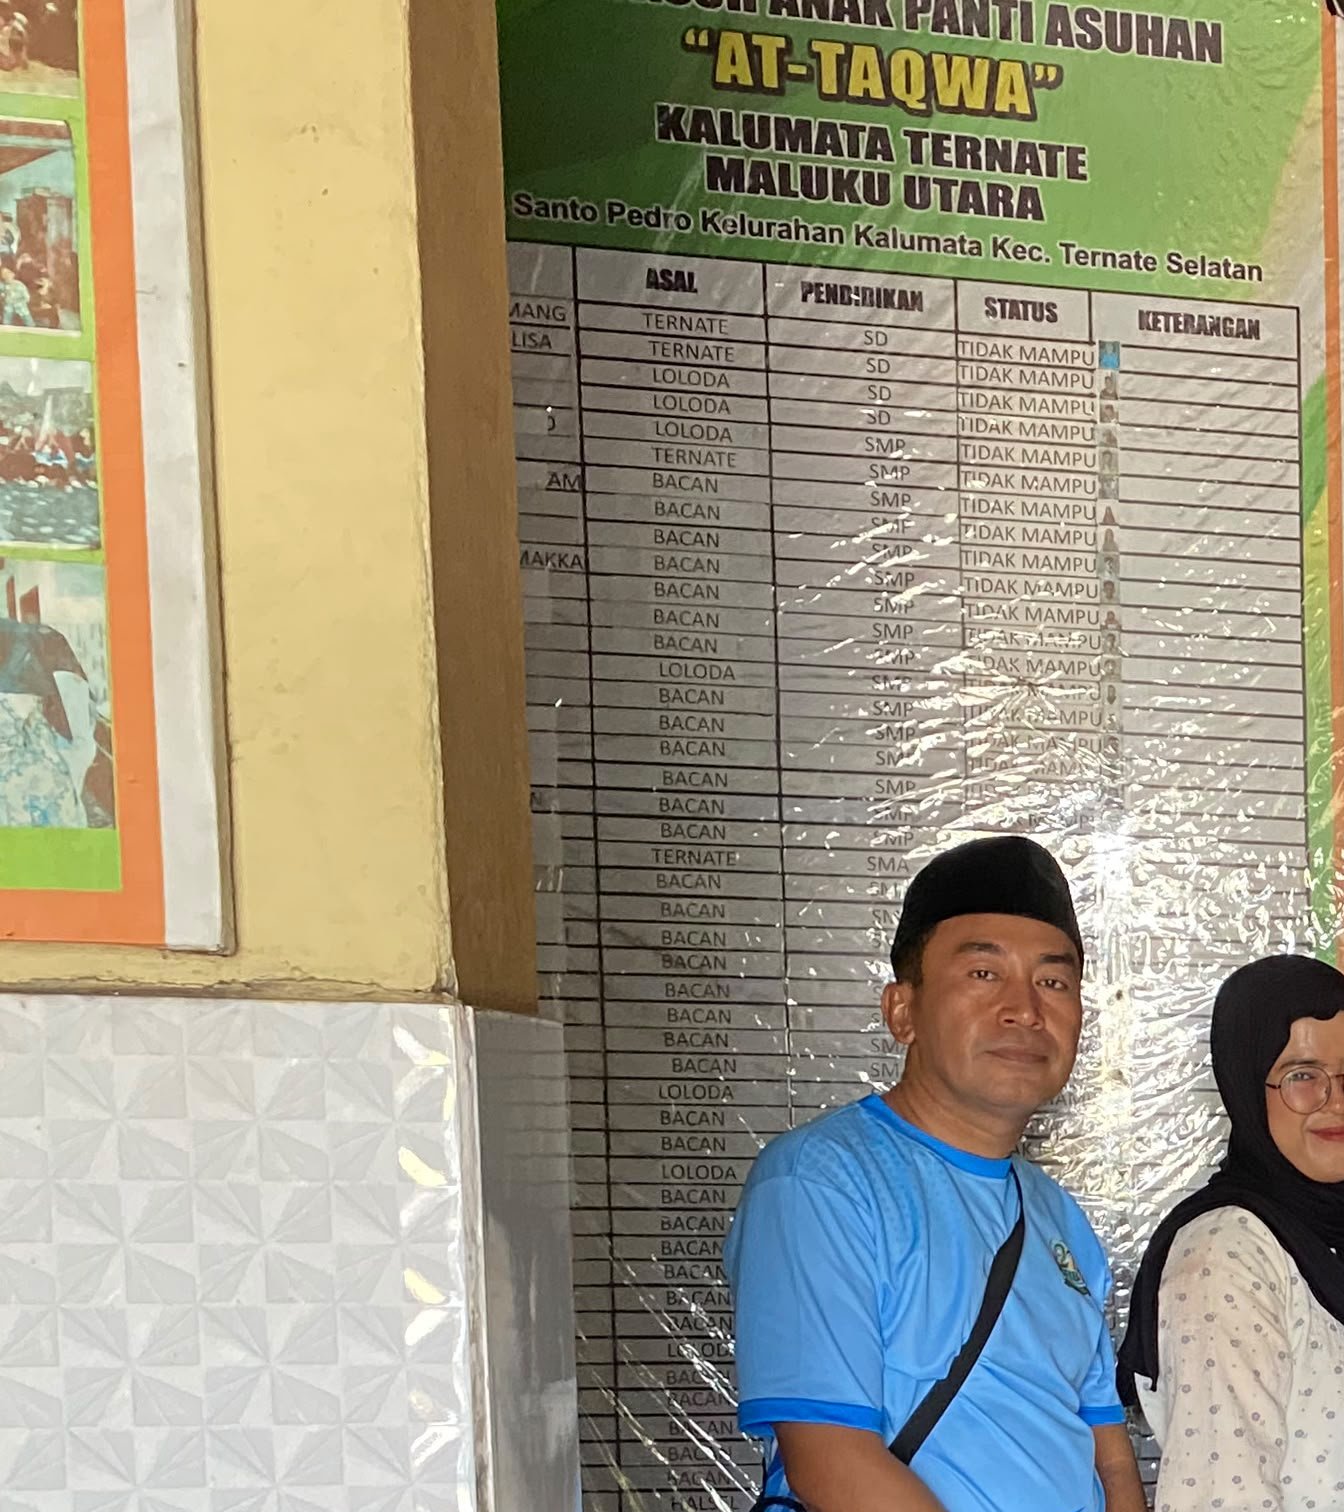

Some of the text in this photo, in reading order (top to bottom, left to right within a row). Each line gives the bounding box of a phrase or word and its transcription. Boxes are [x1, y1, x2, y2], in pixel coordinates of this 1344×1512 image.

[905, 0, 1033, 43] PANTI
[1045, 4, 1223, 64] ASUHAN
[656, 104, 1089, 181] KALUMATA TERNATE
[705, 155, 1045, 222] MALUKU UTARA
[513, 193, 1263, 282] Santo Pedro Kelurahan Kalumata Kec. Ternate Selatan
[645, 267, 1261, 341] ASAL PENDIDIKAN STATUS KETERANGAN
[642, 312, 1095, 368] TERNATE SD TIDAK MAMPU
[648, 340, 735, 364] TERNATE
[866, 357, 891, 376] SD
[652, 367, 730, 389] LOLODA
[655, 420, 733, 444] LOLODA
[652, 472, 912, 509] BACAN SMP
[658, 659, 736, 682] LOLODA
[651, 847, 910, 874] TERNATE SMA
[658, 1083, 734, 1103] LOLODA
[666, 1288, 731, 1307] BACAN
